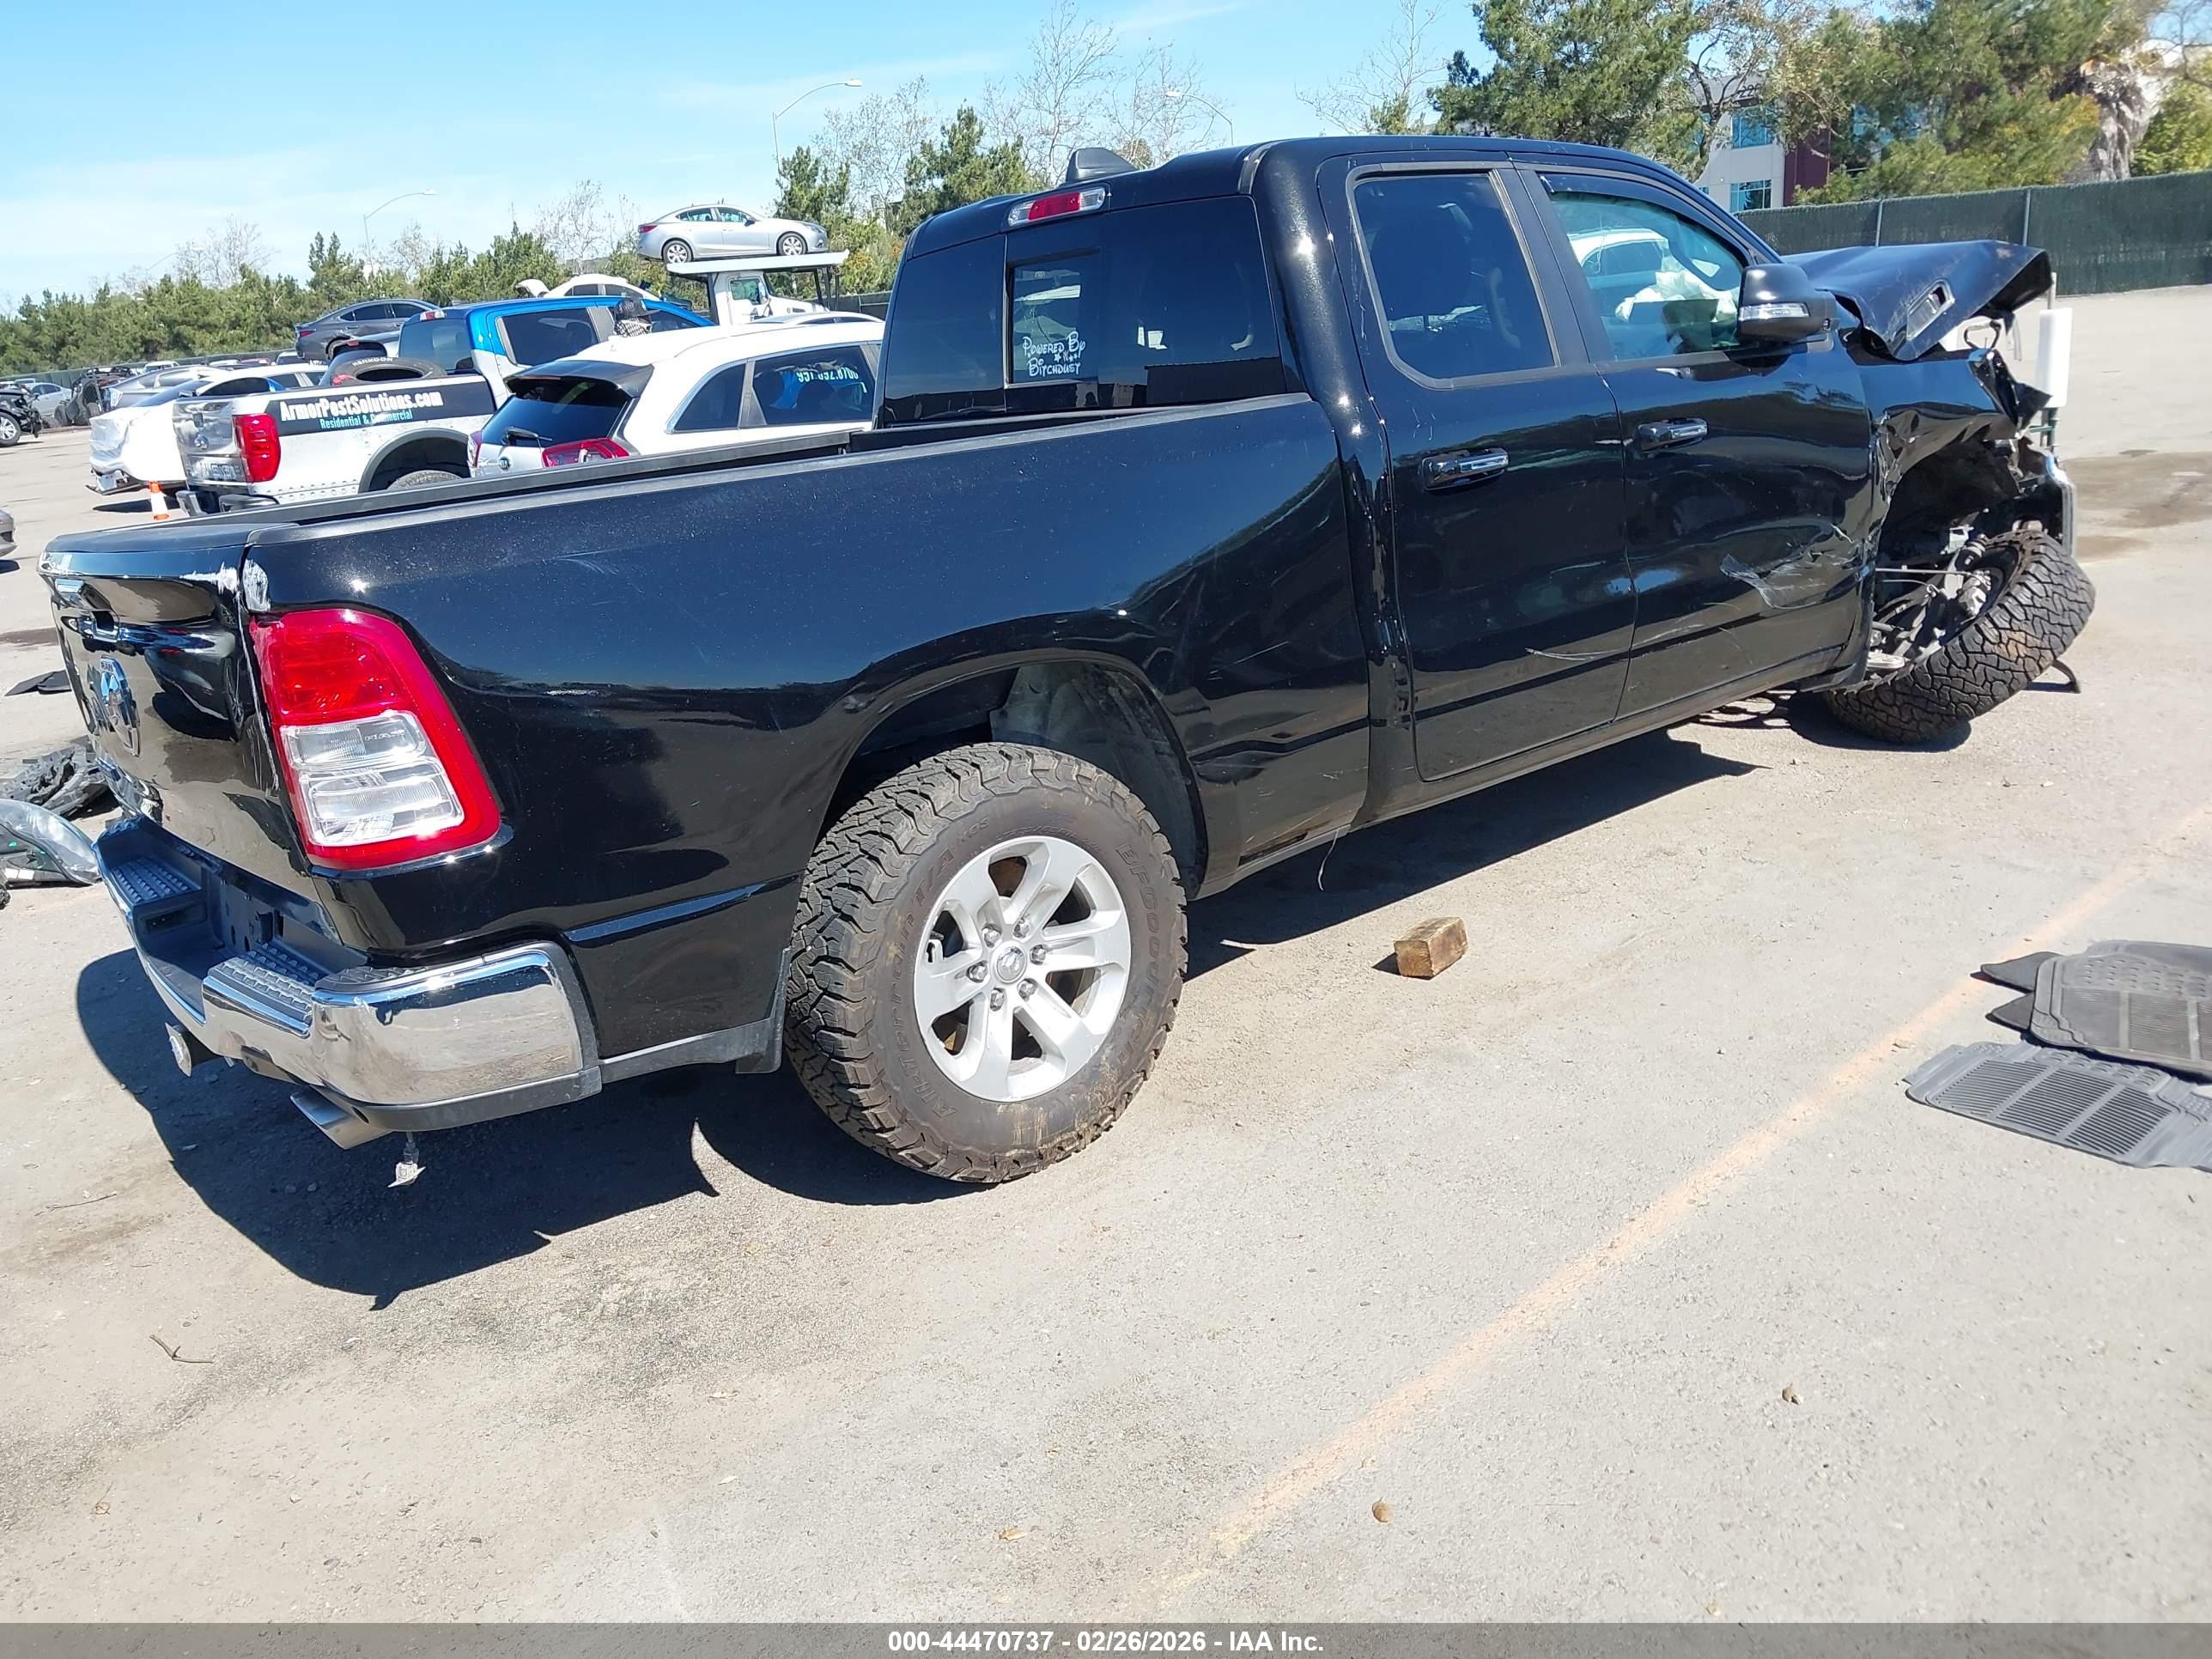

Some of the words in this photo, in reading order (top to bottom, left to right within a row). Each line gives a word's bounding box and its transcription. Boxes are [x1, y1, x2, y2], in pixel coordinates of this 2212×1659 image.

[279, 391, 444, 422] ArmorPestSolutions.com
[319, 415, 362, 429] Residential
[363, 416, 369, 425] &
[370, 410, 413, 426] Cmercial
[100, 661, 113, 672] RAM
